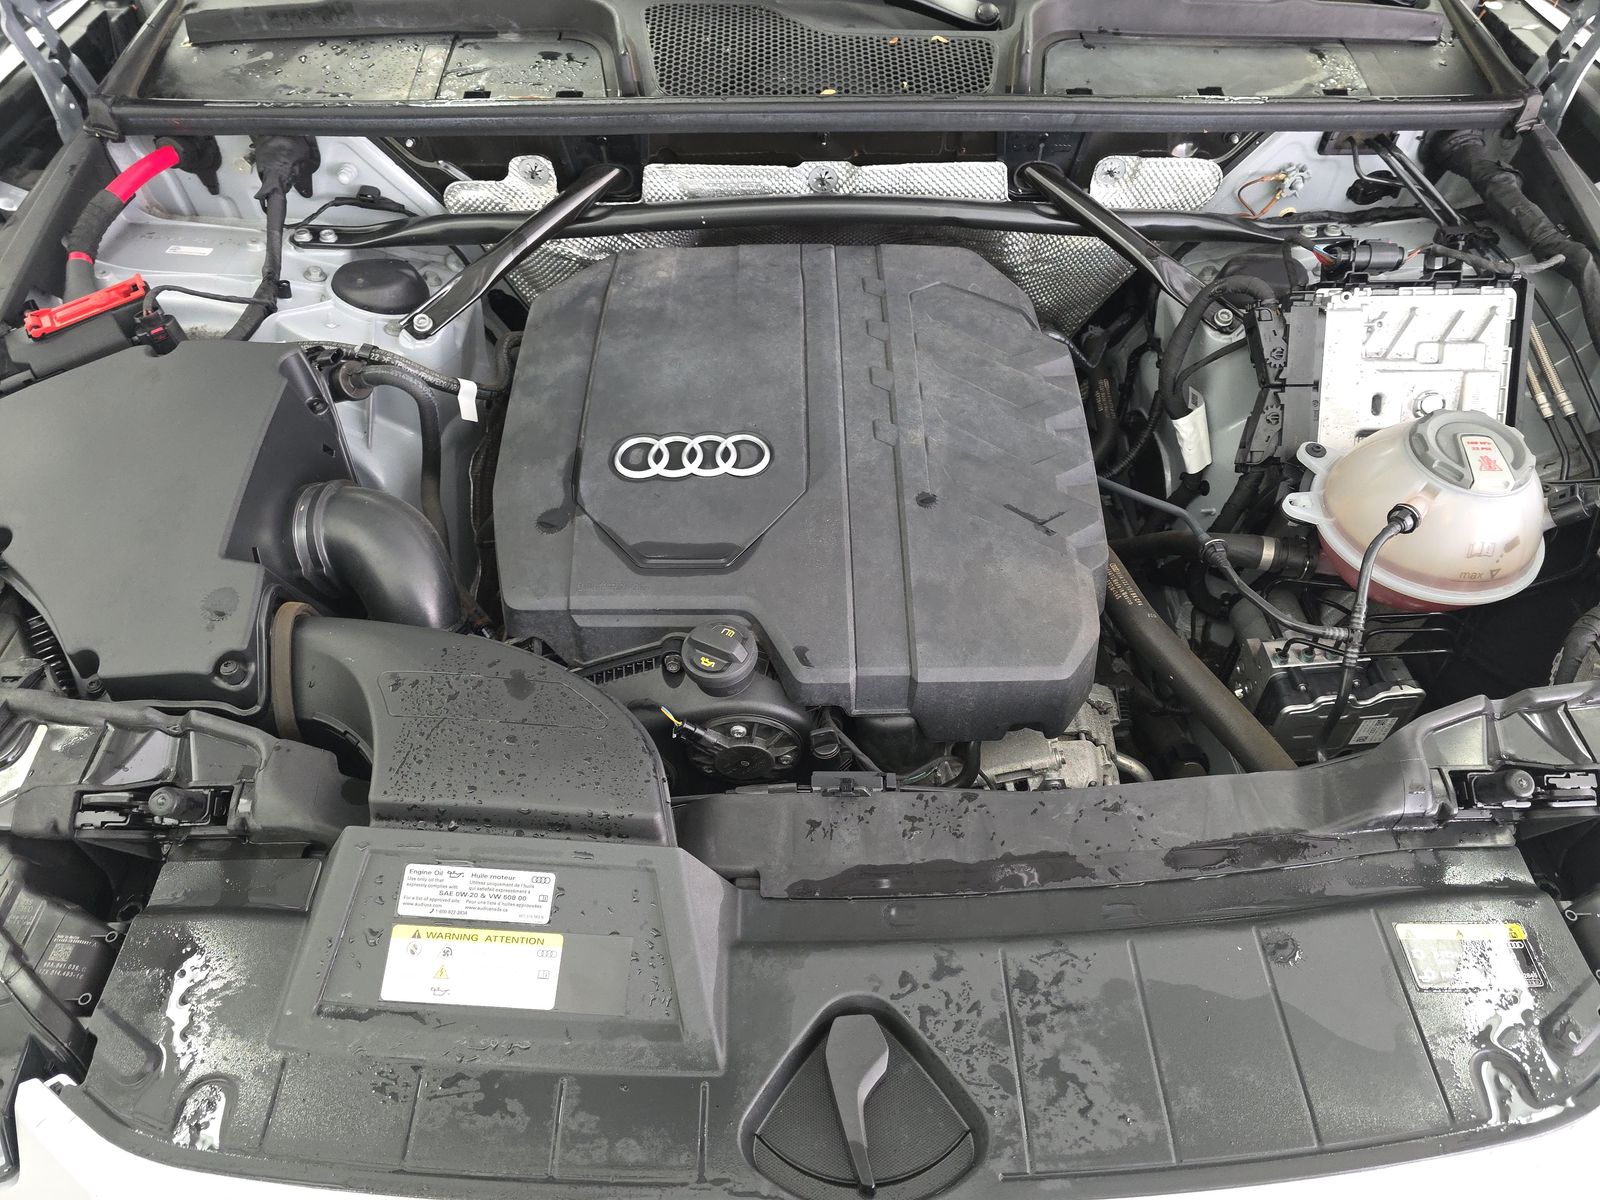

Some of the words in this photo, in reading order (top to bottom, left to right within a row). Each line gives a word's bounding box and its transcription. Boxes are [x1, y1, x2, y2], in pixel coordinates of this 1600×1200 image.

[1460, 571, 1483, 580] max
[409, 868, 432, 876] Engine
[426, 931, 479, 942] WARNING
[485, 935, 545, 945] ATTENTION
